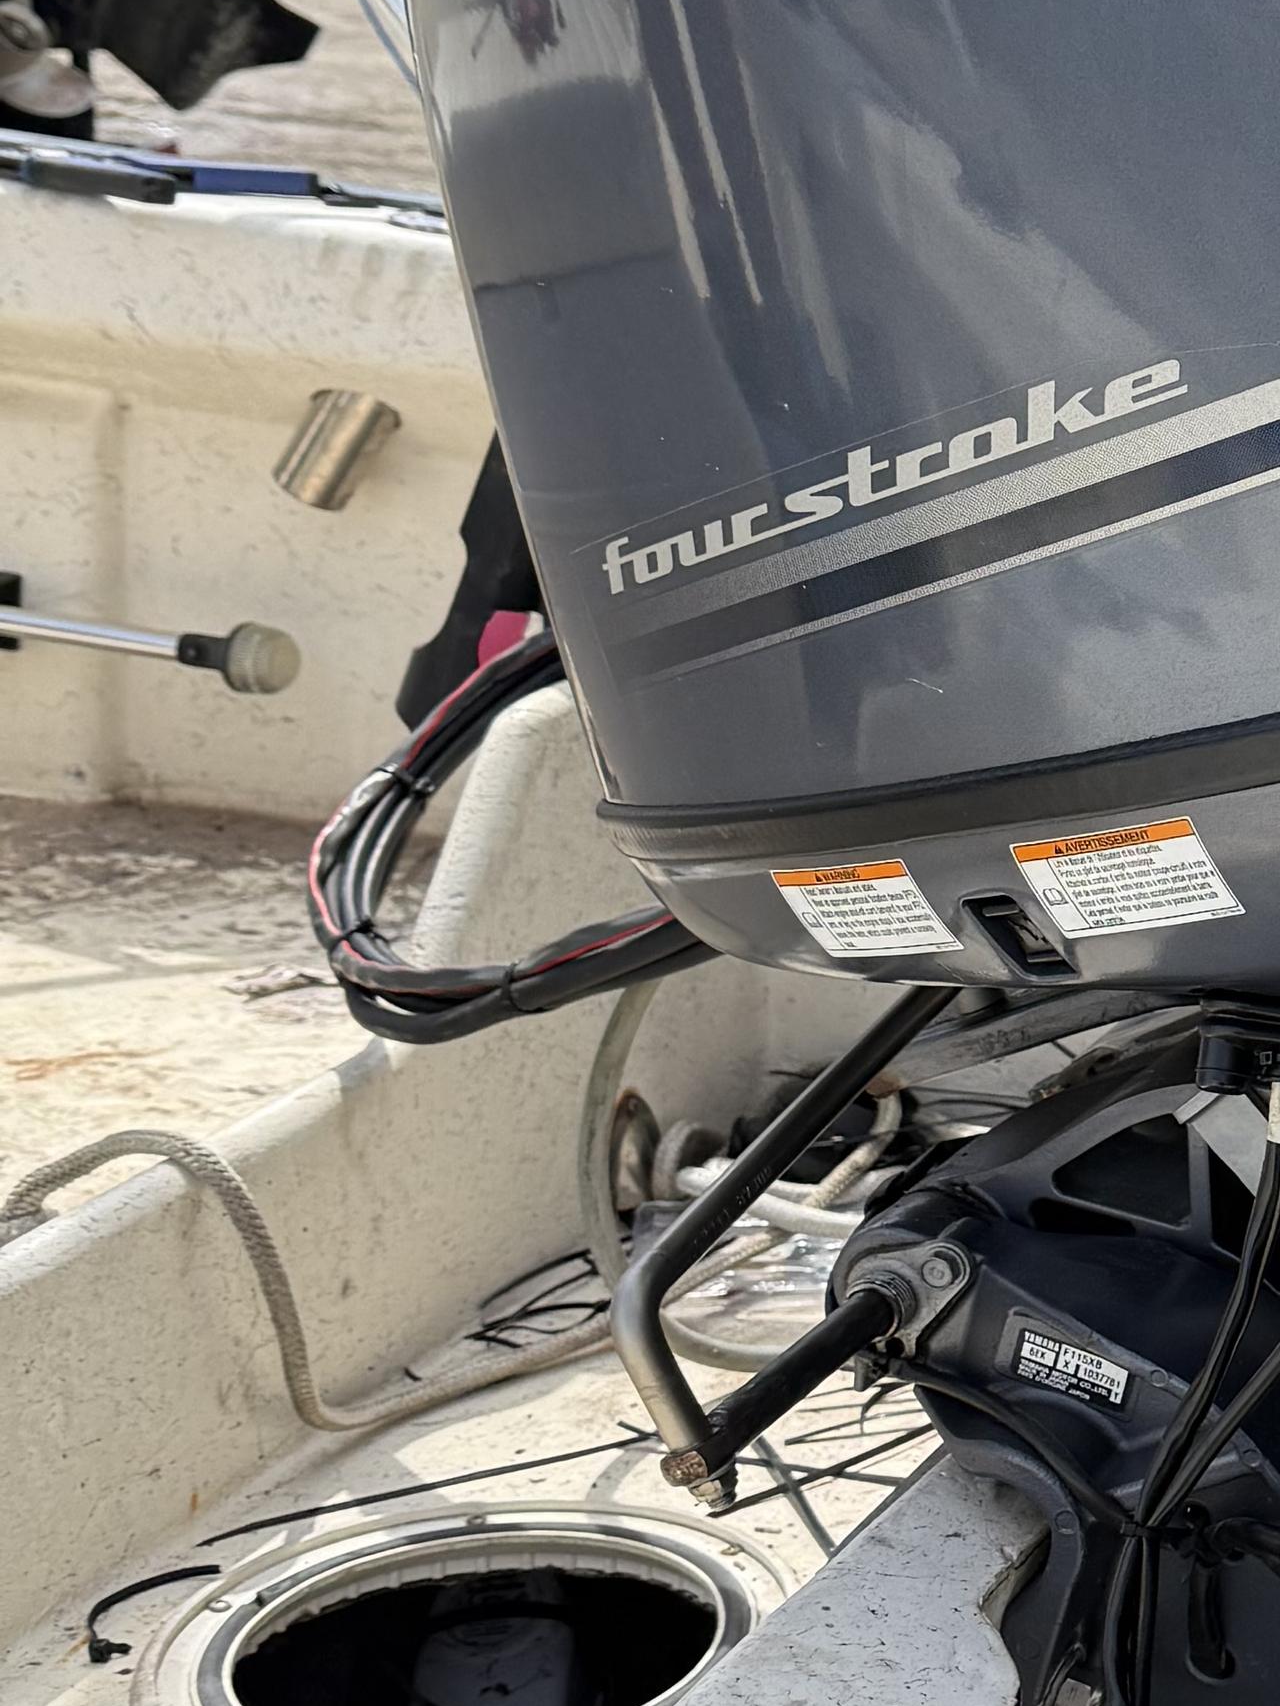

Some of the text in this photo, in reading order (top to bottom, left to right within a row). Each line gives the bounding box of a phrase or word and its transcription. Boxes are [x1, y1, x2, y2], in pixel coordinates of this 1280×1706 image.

[602, 358, 1189, 595] four stroke
[1064, 829, 1150, 853] AVERTISSEMENT
[1024, 1330, 1060, 1352] YAMAHA
[1063, 1347, 1103, 1370] F115XB
